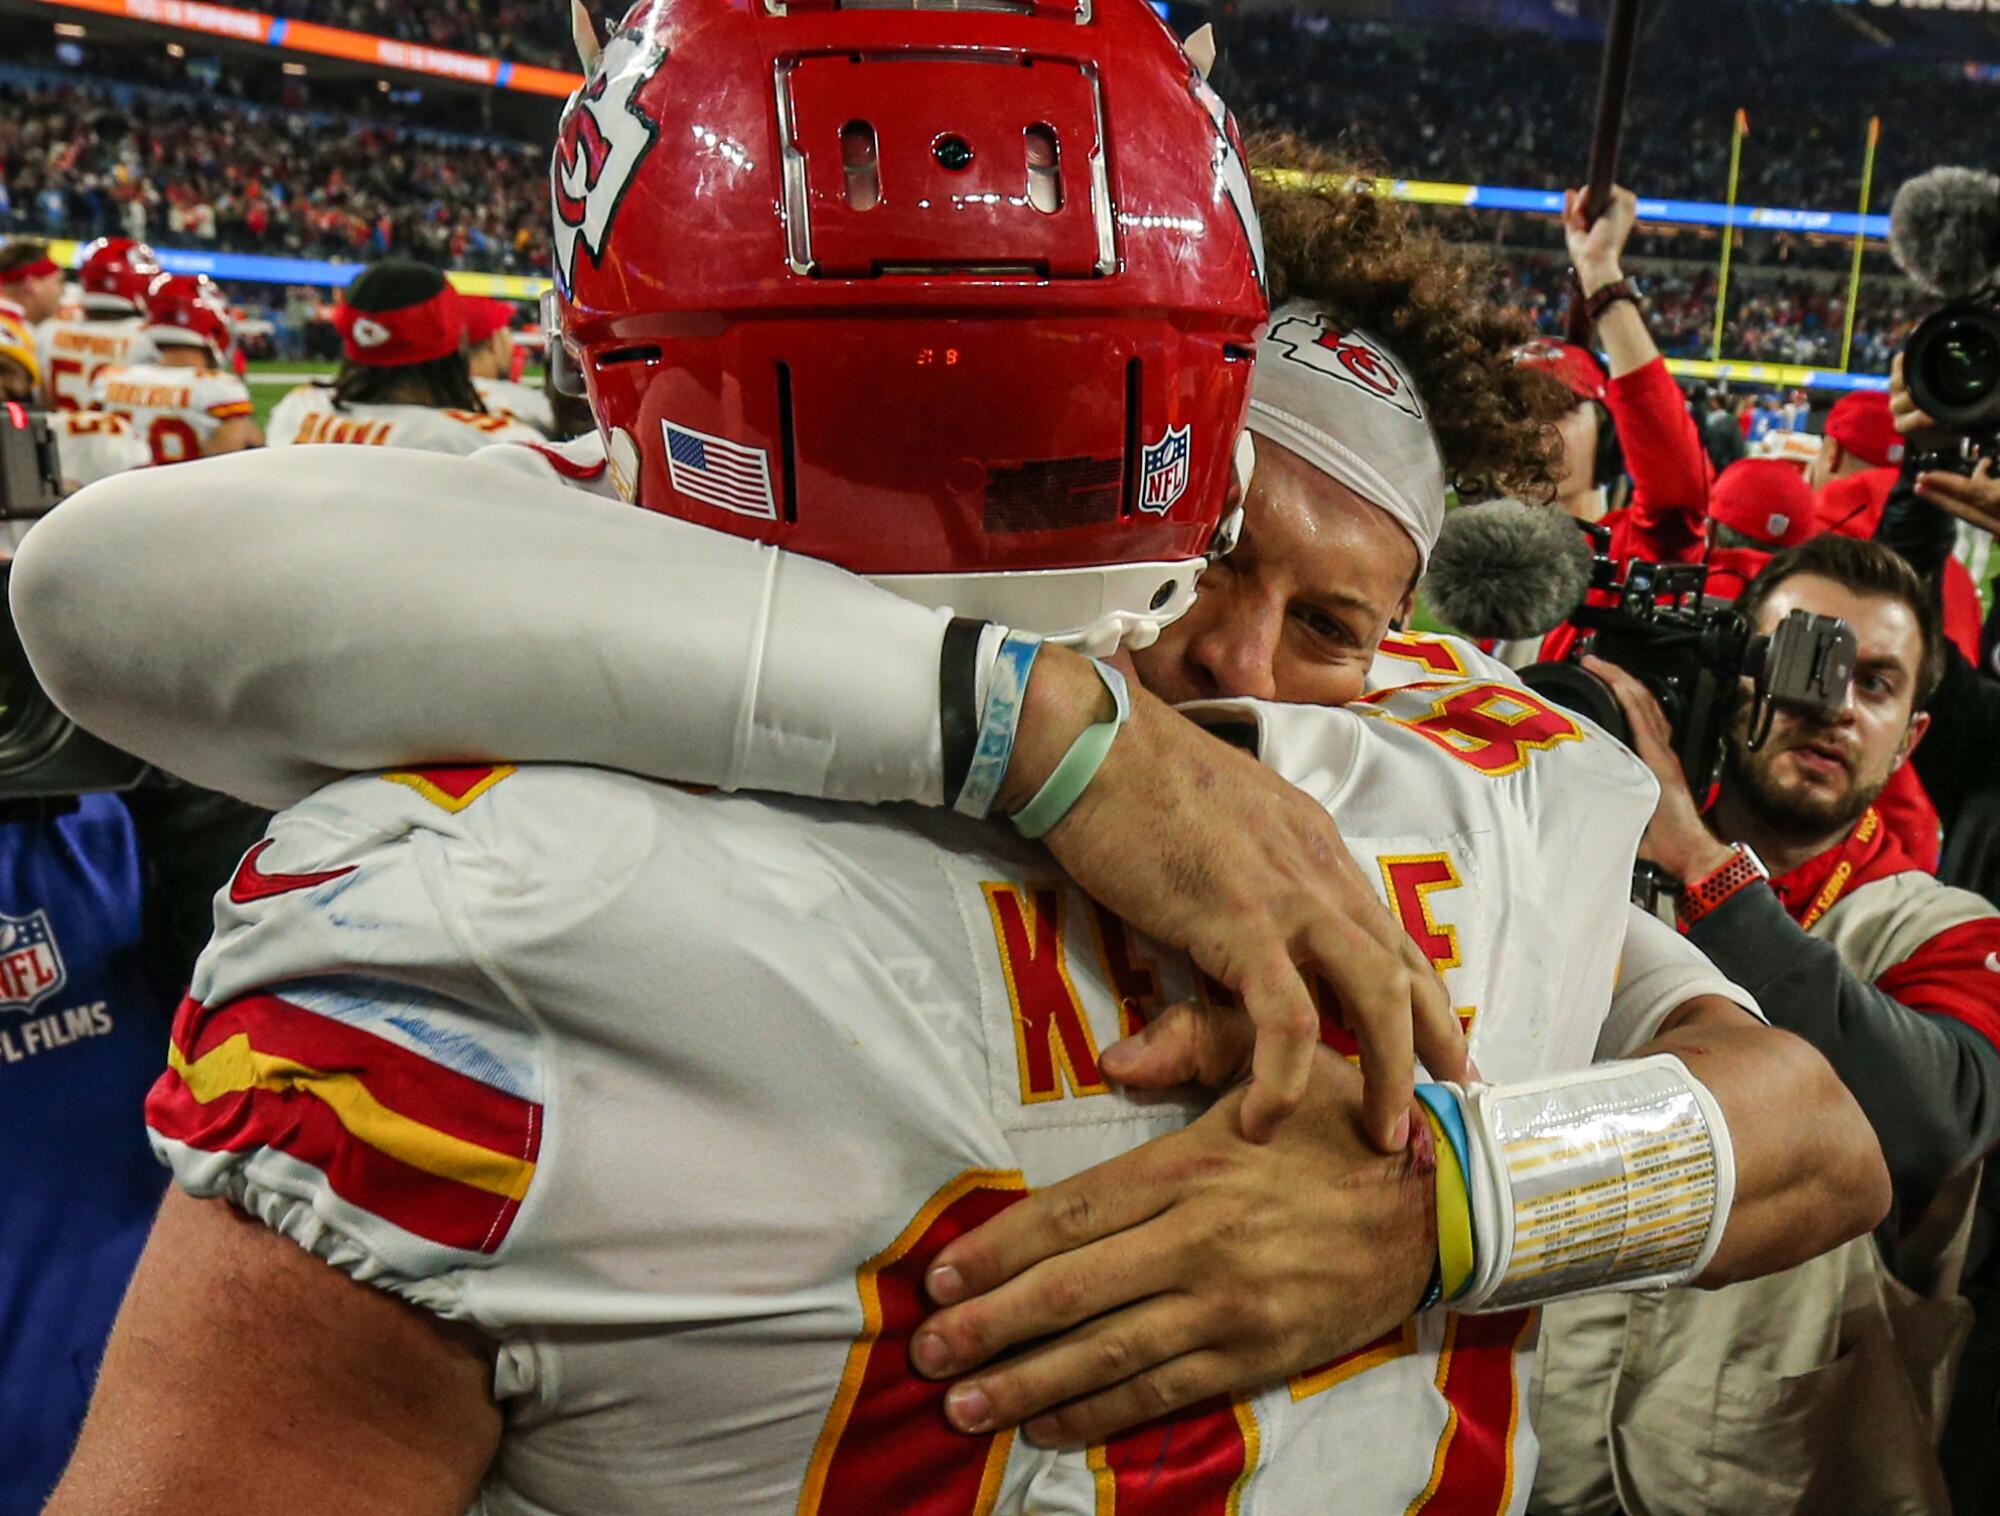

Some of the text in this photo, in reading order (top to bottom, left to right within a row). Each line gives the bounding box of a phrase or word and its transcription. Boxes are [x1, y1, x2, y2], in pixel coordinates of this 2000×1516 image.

[1146, 461, 1183, 503] NFL
[1816, 860, 1852, 912] CHIEFS
[20, 1000, 113, 1055] FILMS
